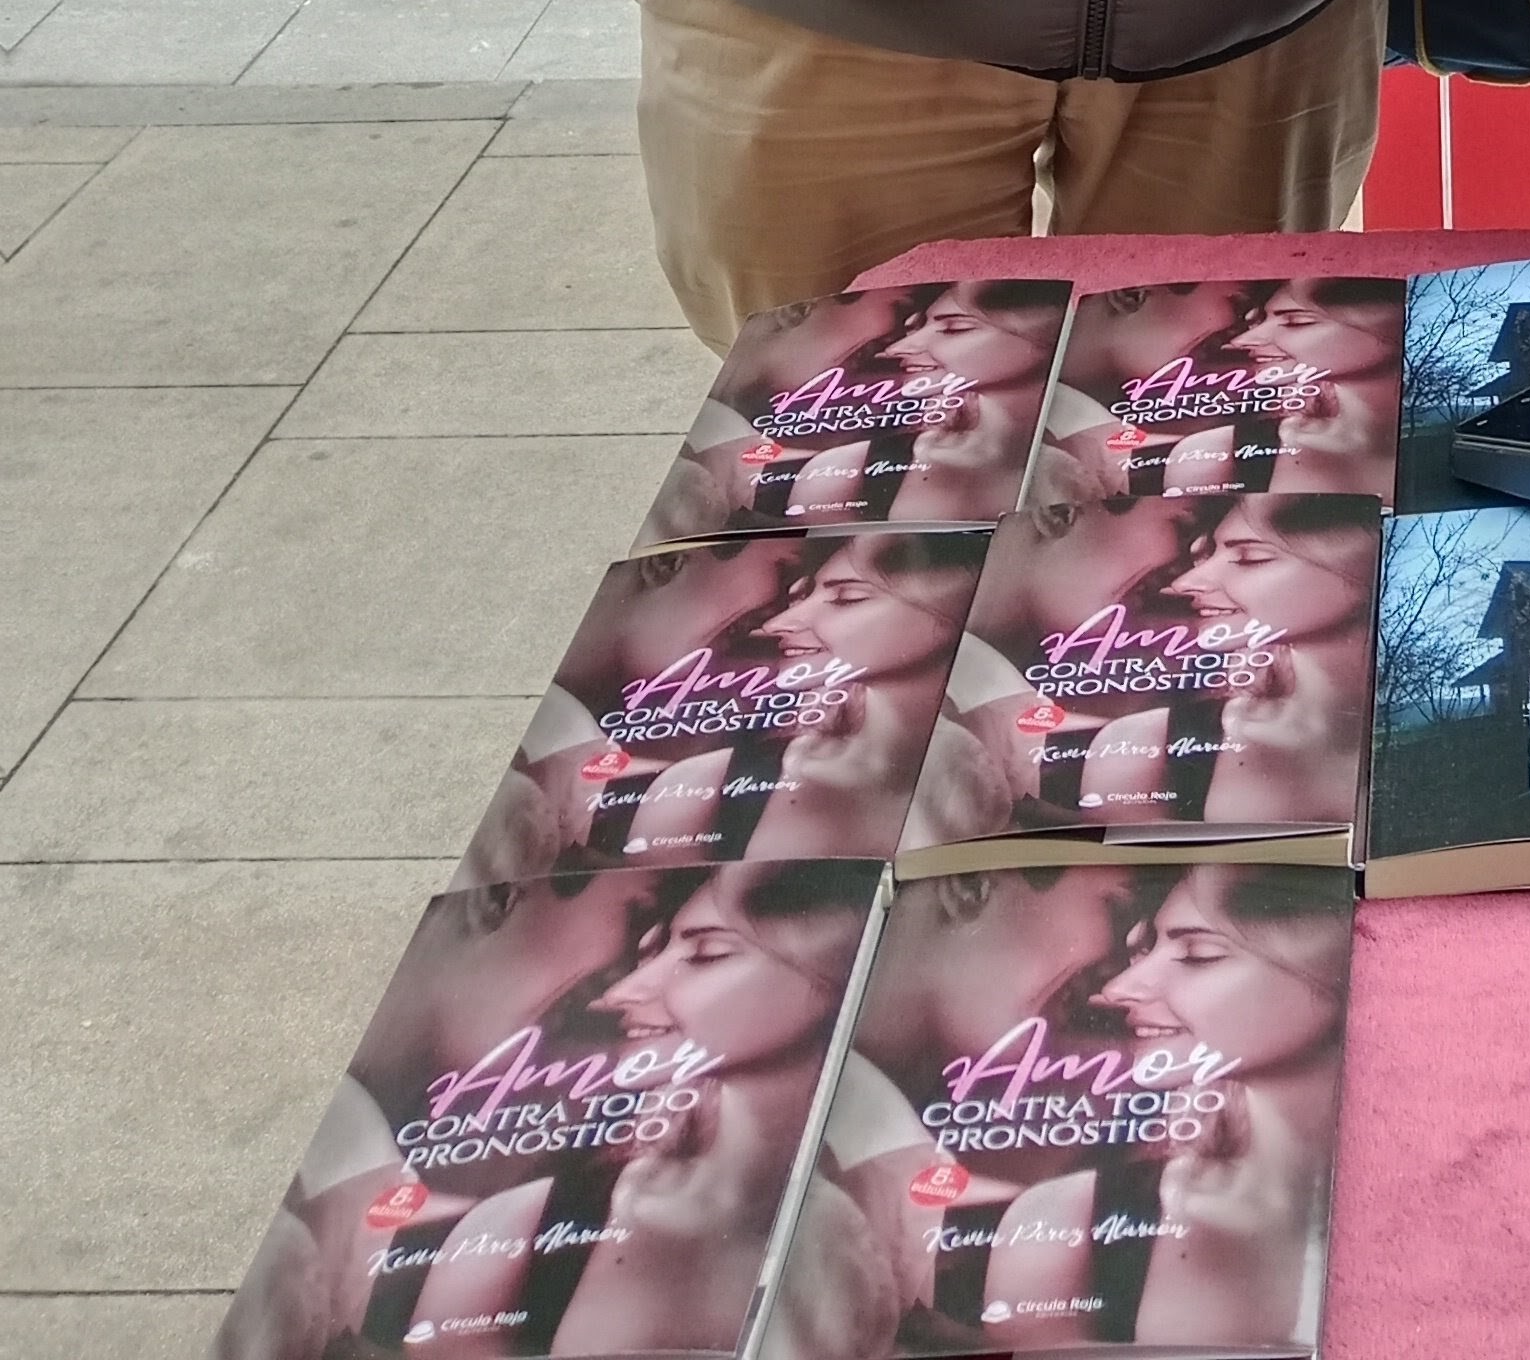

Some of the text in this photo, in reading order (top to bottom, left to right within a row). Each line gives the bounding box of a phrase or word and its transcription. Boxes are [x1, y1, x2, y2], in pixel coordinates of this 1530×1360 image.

[769, 367, 980, 416] Amor
[1110, 385, 1321, 414] CONTRA TODO
[1121, 356, 1332, 405] Amor
[752, 396, 965, 428] CONTRA TODO
[761, 411, 947, 439] PRONÓSTICO
[1121, 398, 1306, 426] PRONÓSTICO
[1039, 603, 1289, 672] Amor
[621, 647, 868, 714] Amor
[1025, 651, 1274, 682] CONTRA TODO
[1036, 670, 1257, 699] PRONÓSTICO
[600, 690, 850, 729] CONTRA TODO
[606, 709, 826, 746] PRONÓSTICO
[426, 1025, 726, 1125] Amor
[941, 1016, 1243, 1117] Amor
[396, 1088, 700, 1147] CONTRA TODO
[922, 1090, 1226, 1128] CONTRA TODO
[401, 1117, 671, 1173] PRONÓSTICO
[935, 1116, 1203, 1155] PRONÓSTICO
[921, 1225, 1003, 1254] Kevin
